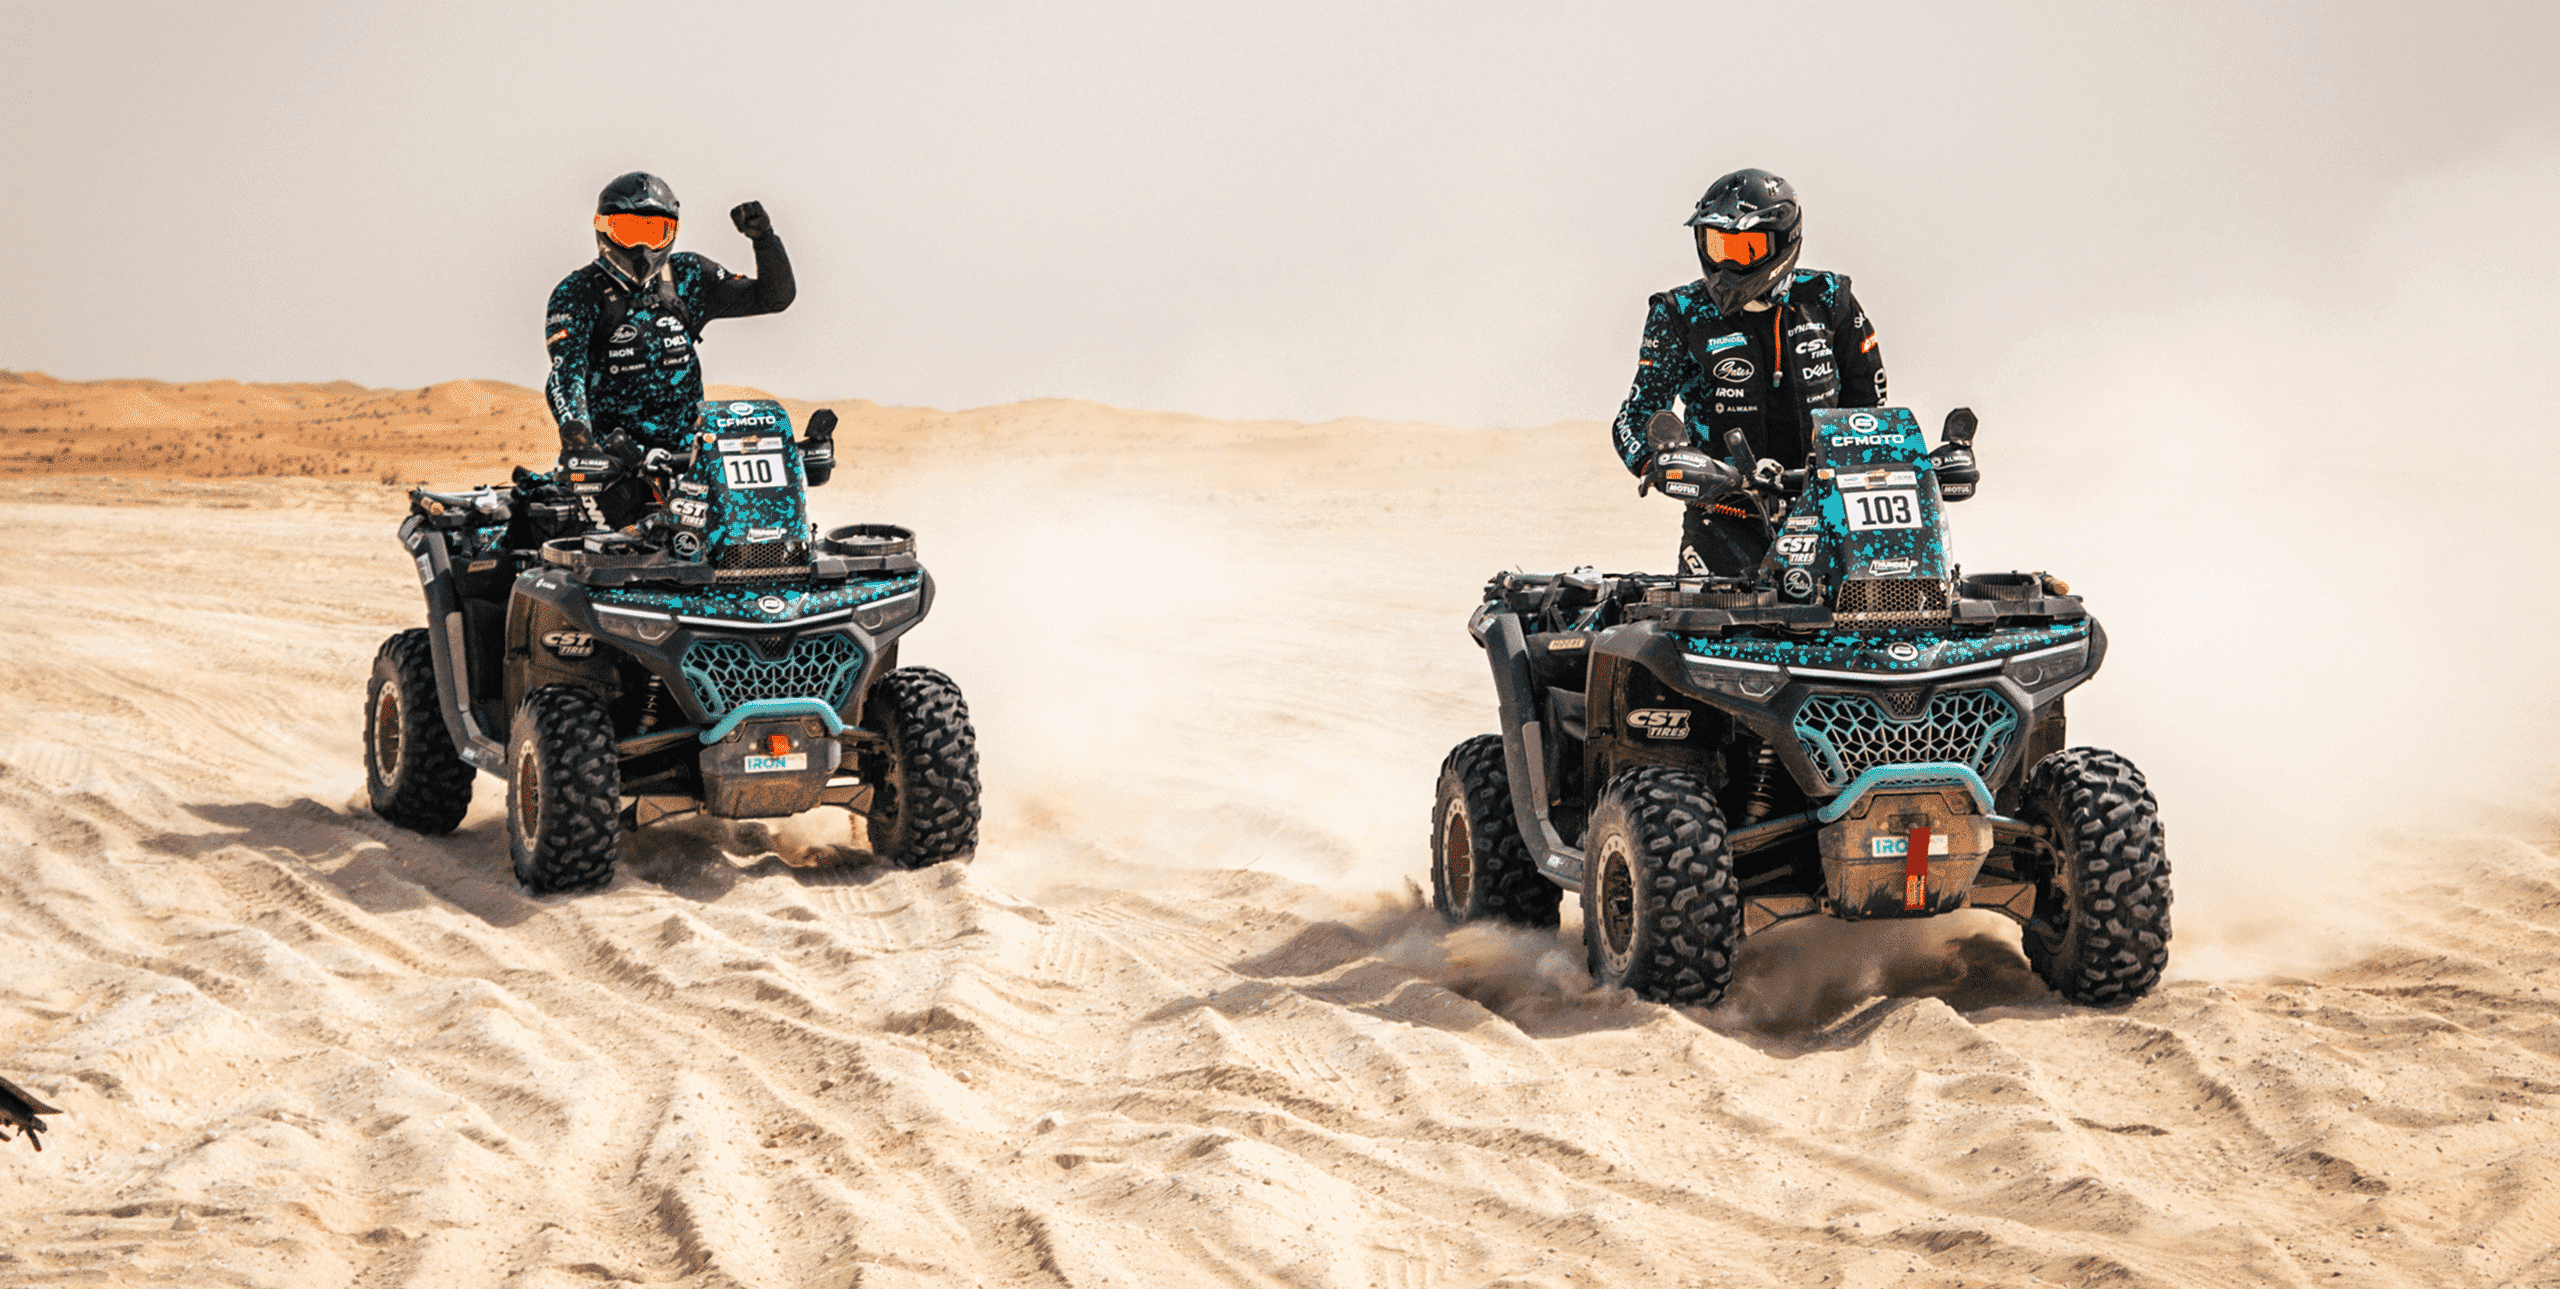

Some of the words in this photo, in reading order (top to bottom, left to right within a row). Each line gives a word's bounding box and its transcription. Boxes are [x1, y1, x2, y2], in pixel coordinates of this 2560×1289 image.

[608, 347, 635, 358] IRON
[1717, 360, 1752, 380] Gates
[1802, 361, 1834, 380] DELL
[1715, 387, 1745, 398] IRON
[1726, 405, 1759, 413] ALWARK
[717, 415, 776, 428] CFMOTO
[1831, 434, 1905, 447] CFMOTO
[729, 459, 773, 484] 110
[1668, 484, 1697, 494] MOTUL
[671, 500, 708, 517] CST
[1857, 495, 1912, 526] 103
[1778, 537, 1816, 553] CST
[1790, 552, 1815, 564] TIRES
[544, 633, 593, 646] CST
[561, 645, 592, 655] TIRES
[1629, 711, 1688, 728] CST
[1649, 726, 1688, 737] TIRES
[747, 757, 786, 770] IRON
[1875, 838, 1909, 854] IRO
